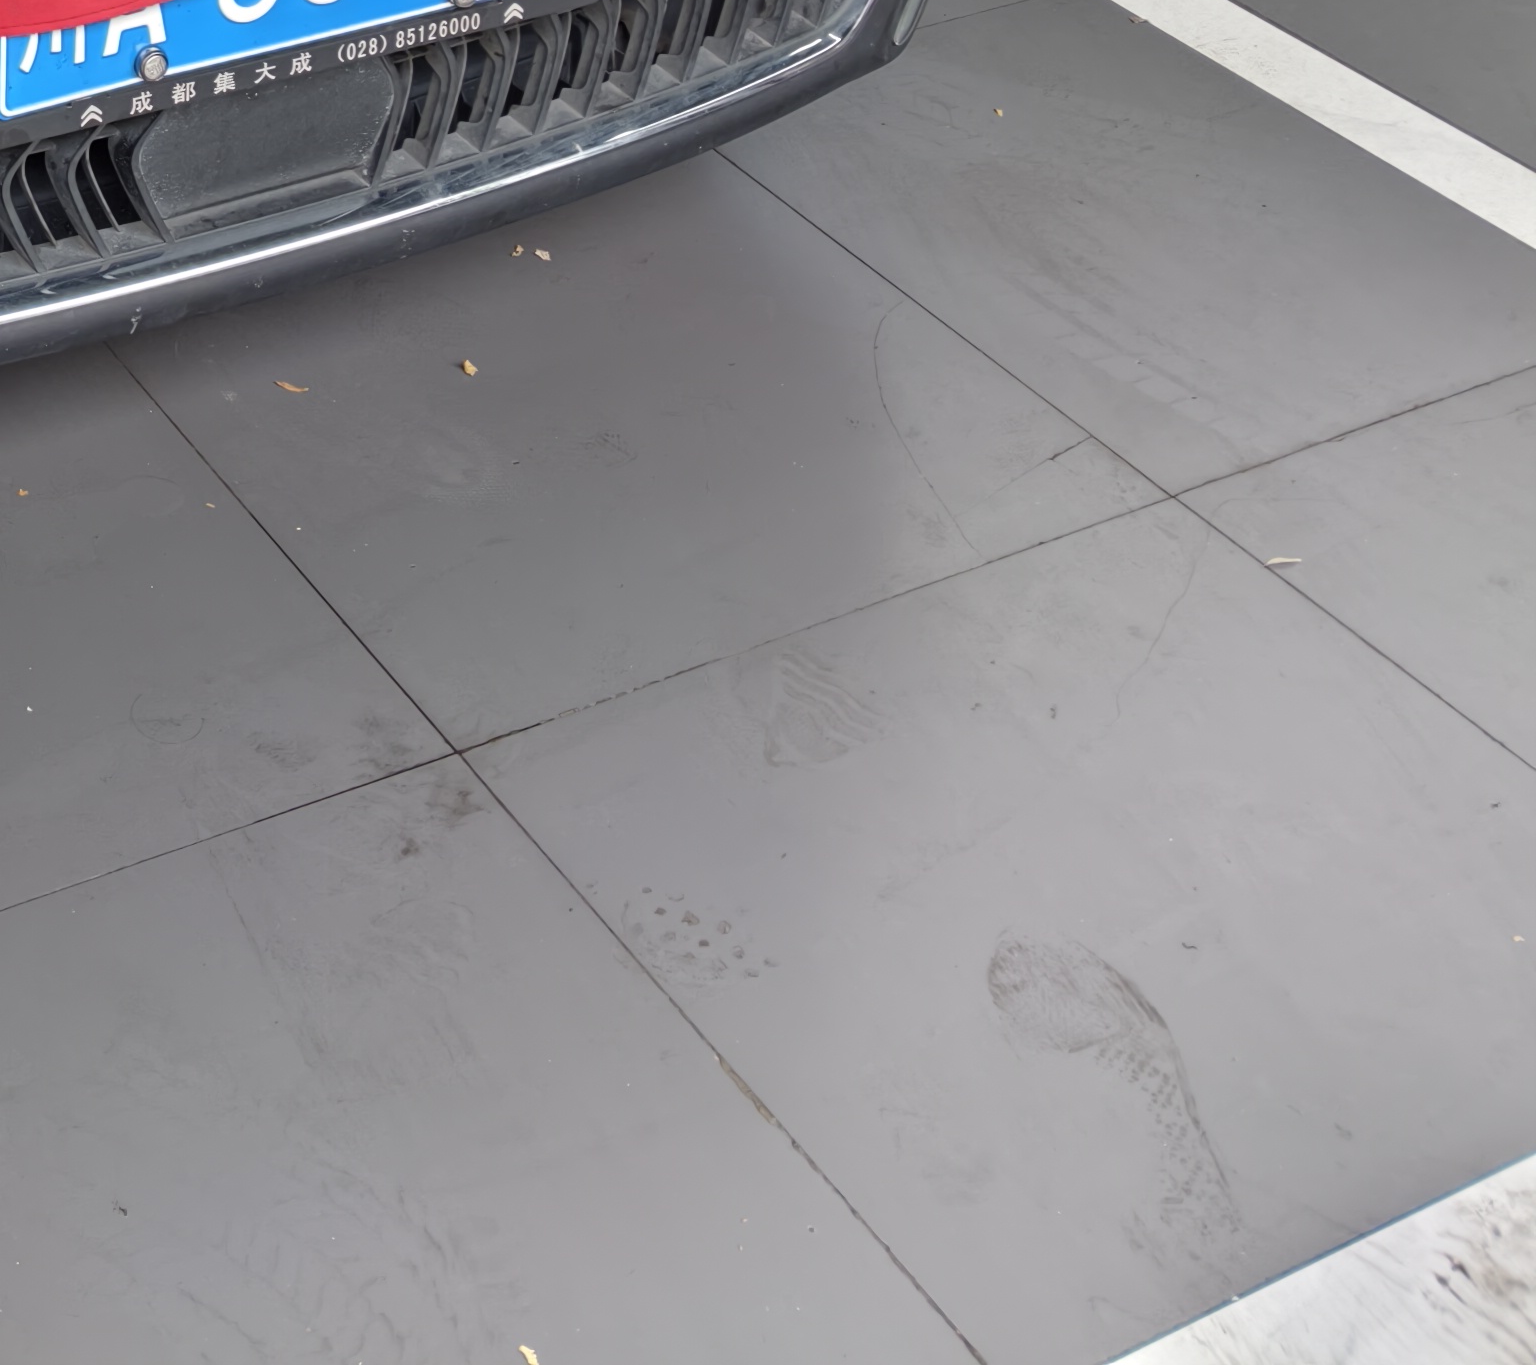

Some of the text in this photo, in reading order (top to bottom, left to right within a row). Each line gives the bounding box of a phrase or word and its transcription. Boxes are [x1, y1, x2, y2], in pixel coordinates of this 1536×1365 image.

[129, 12, 482, 116] 成都集大成 (028) 85126000
